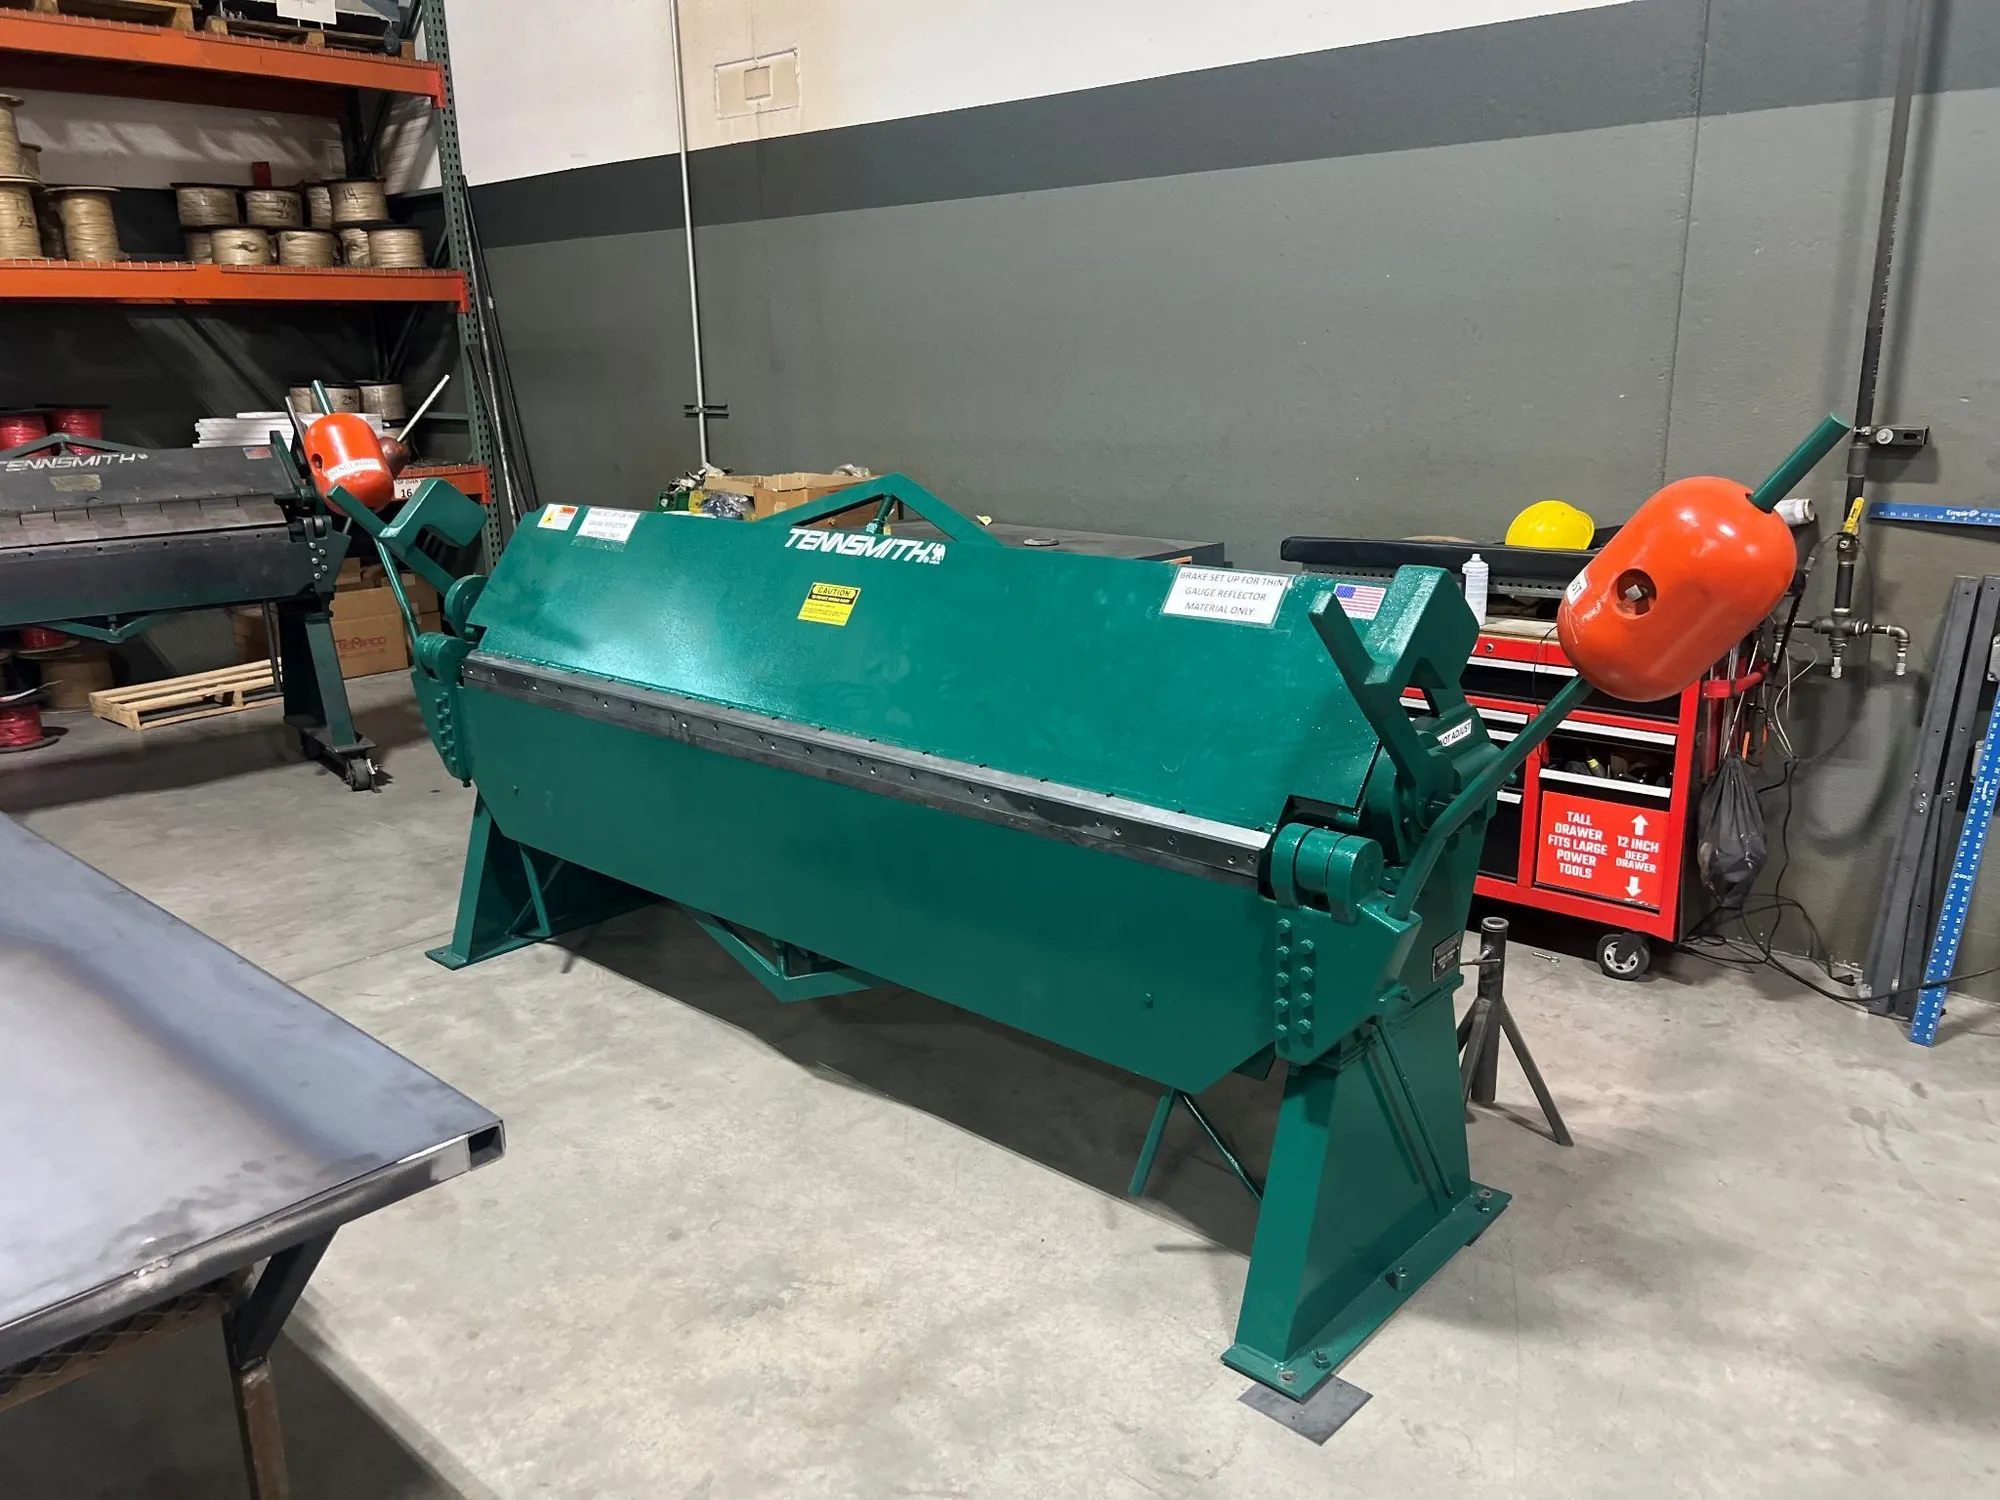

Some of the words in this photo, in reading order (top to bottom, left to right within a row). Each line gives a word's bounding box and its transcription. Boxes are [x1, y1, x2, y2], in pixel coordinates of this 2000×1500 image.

[401, 488, 412, 498] 16
[784, 528, 936, 563] TENNSMITH
[1180, 571, 1208, 581] BRAKE
[1210, 573, 1225, 582] SET
[1227, 575, 1240, 583] UP
[1241, 576, 1260, 585] FOR
[1262, 577, 1285, 587] THIN
[817, 586, 851, 597] CAUTION
[1184, 587, 1216, 597] GAUGE
[1217, 589, 1267, 601] REFLECTOR
[1184, 602, 1229, 614] MATERIAL
[1230, 606, 1255, 616] ONLY
[1442, 733, 1450, 745] OT
[1567, 811, 1592, 826] TALL
[1555, 822, 1603, 841] DRAWER
[1548, 834, 1571, 849] FITS
[1573, 839, 1608, 856] LARGE
[1617, 835, 1629, 848] 12
[1631, 838, 1660, 853] INCH
[1556, 849, 1597, 867] POWER
[1625, 850, 1649, 862] DEEP
[1559, 862, 1592, 879] TOOLS
[1616, 857, 1656, 873] DRAWER
